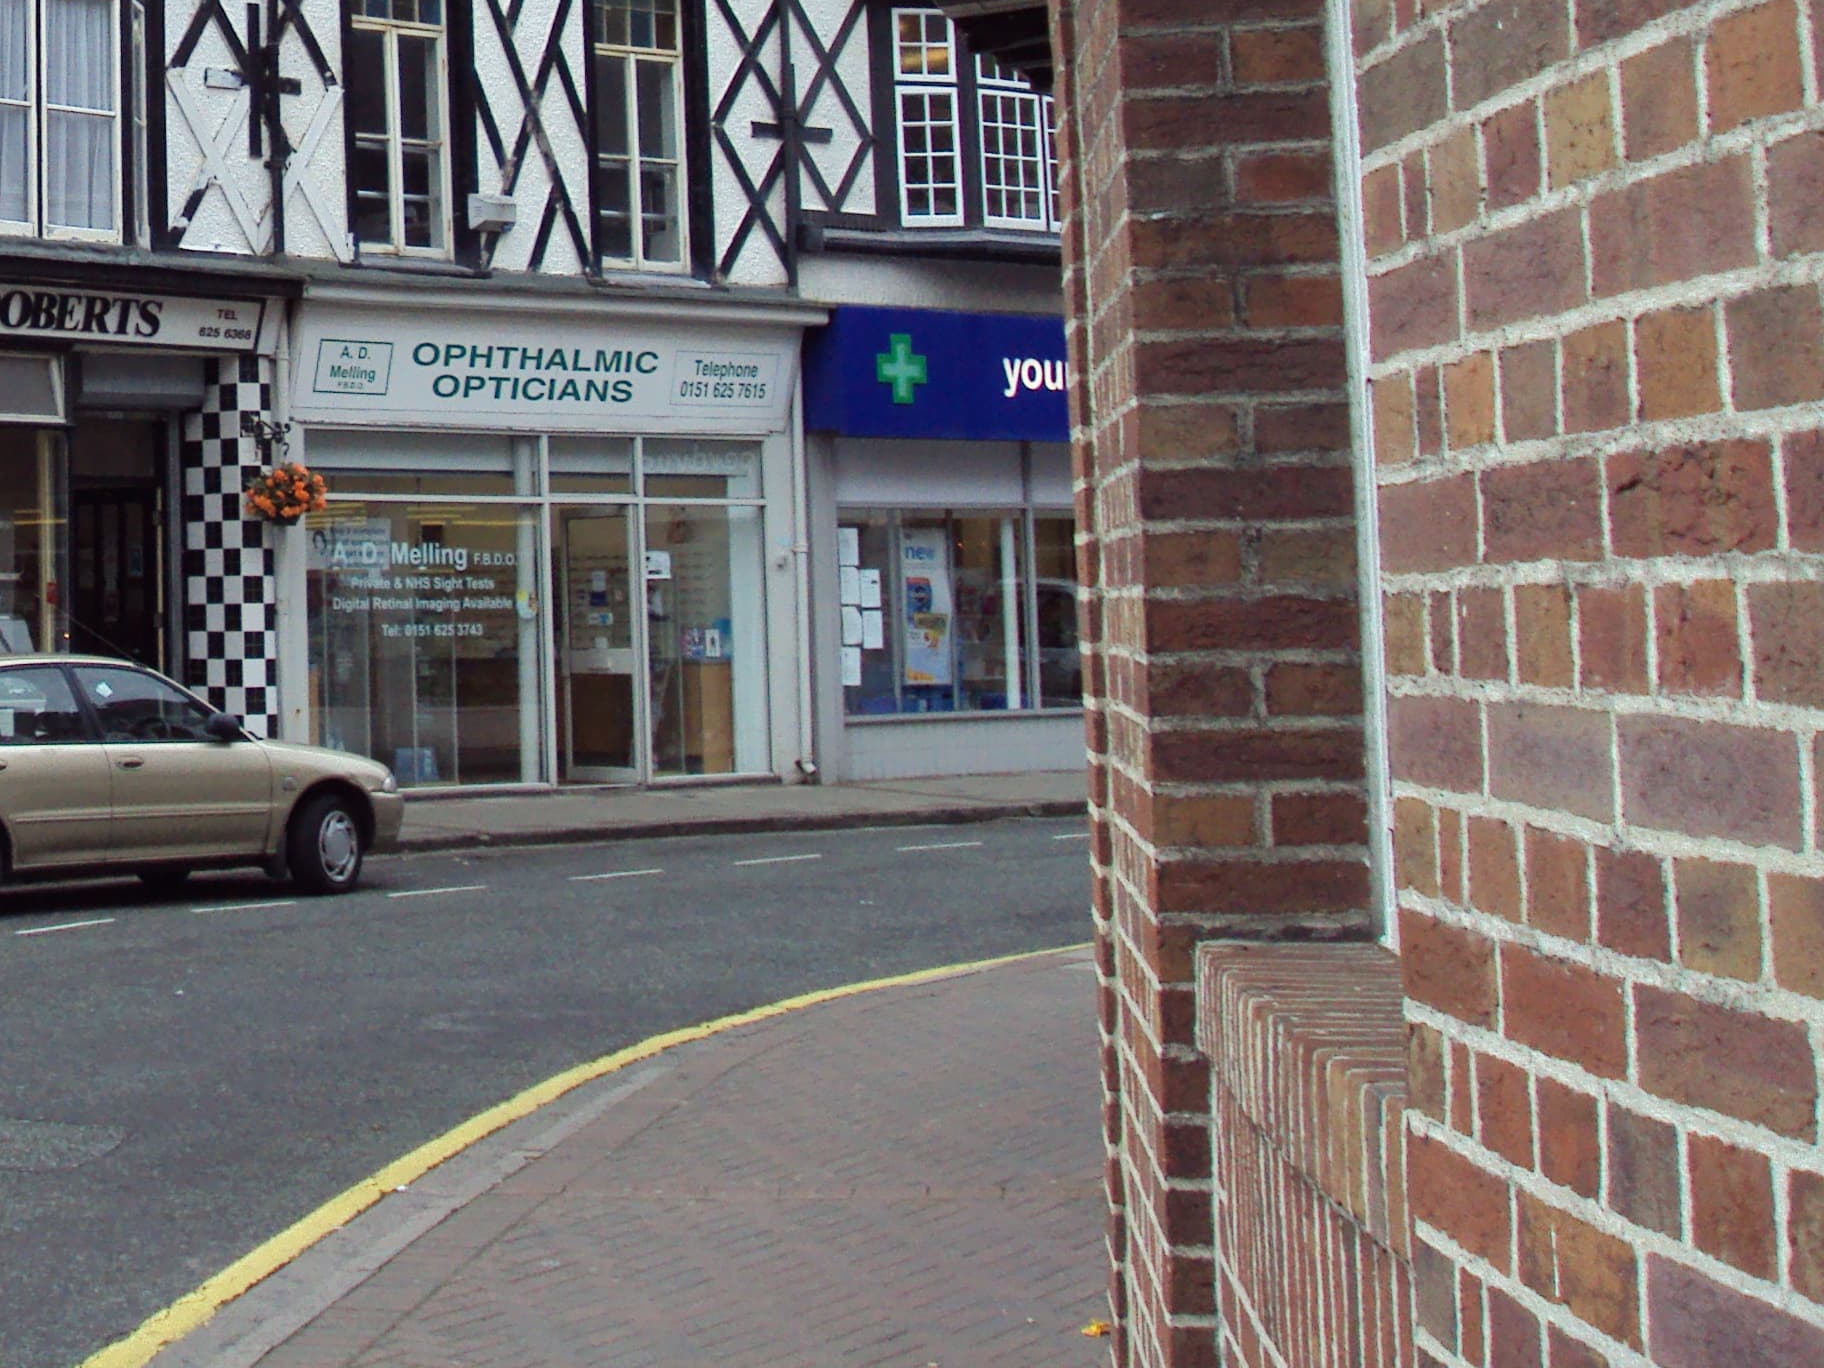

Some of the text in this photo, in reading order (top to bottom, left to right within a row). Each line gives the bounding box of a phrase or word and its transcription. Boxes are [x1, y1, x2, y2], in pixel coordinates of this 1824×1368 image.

[217, 309, 238, 320] TEL
[199, 327, 220, 338] 625
[412, 342, 659, 374] OPHTHALMIC
[329, 365, 376, 383] Melling
[695, 360, 758, 380] Telephone
[1002, 358, 1068, 398] you
[432, 374, 634, 403] OPTICIANS
[680, 380, 766, 399] 0151 625 7615
[391, 543, 468, 571] Melling
[351, 578, 390, 589] Private
[406, 578, 430, 589] NHS
[433, 577, 463, 592] Sight
[466, 578, 495, 589] Tests
[333, 597, 513, 613] Digital Retinal Imaging Available
[404, 624, 430, 636] 0151
[434, 625, 455, 636] 625
